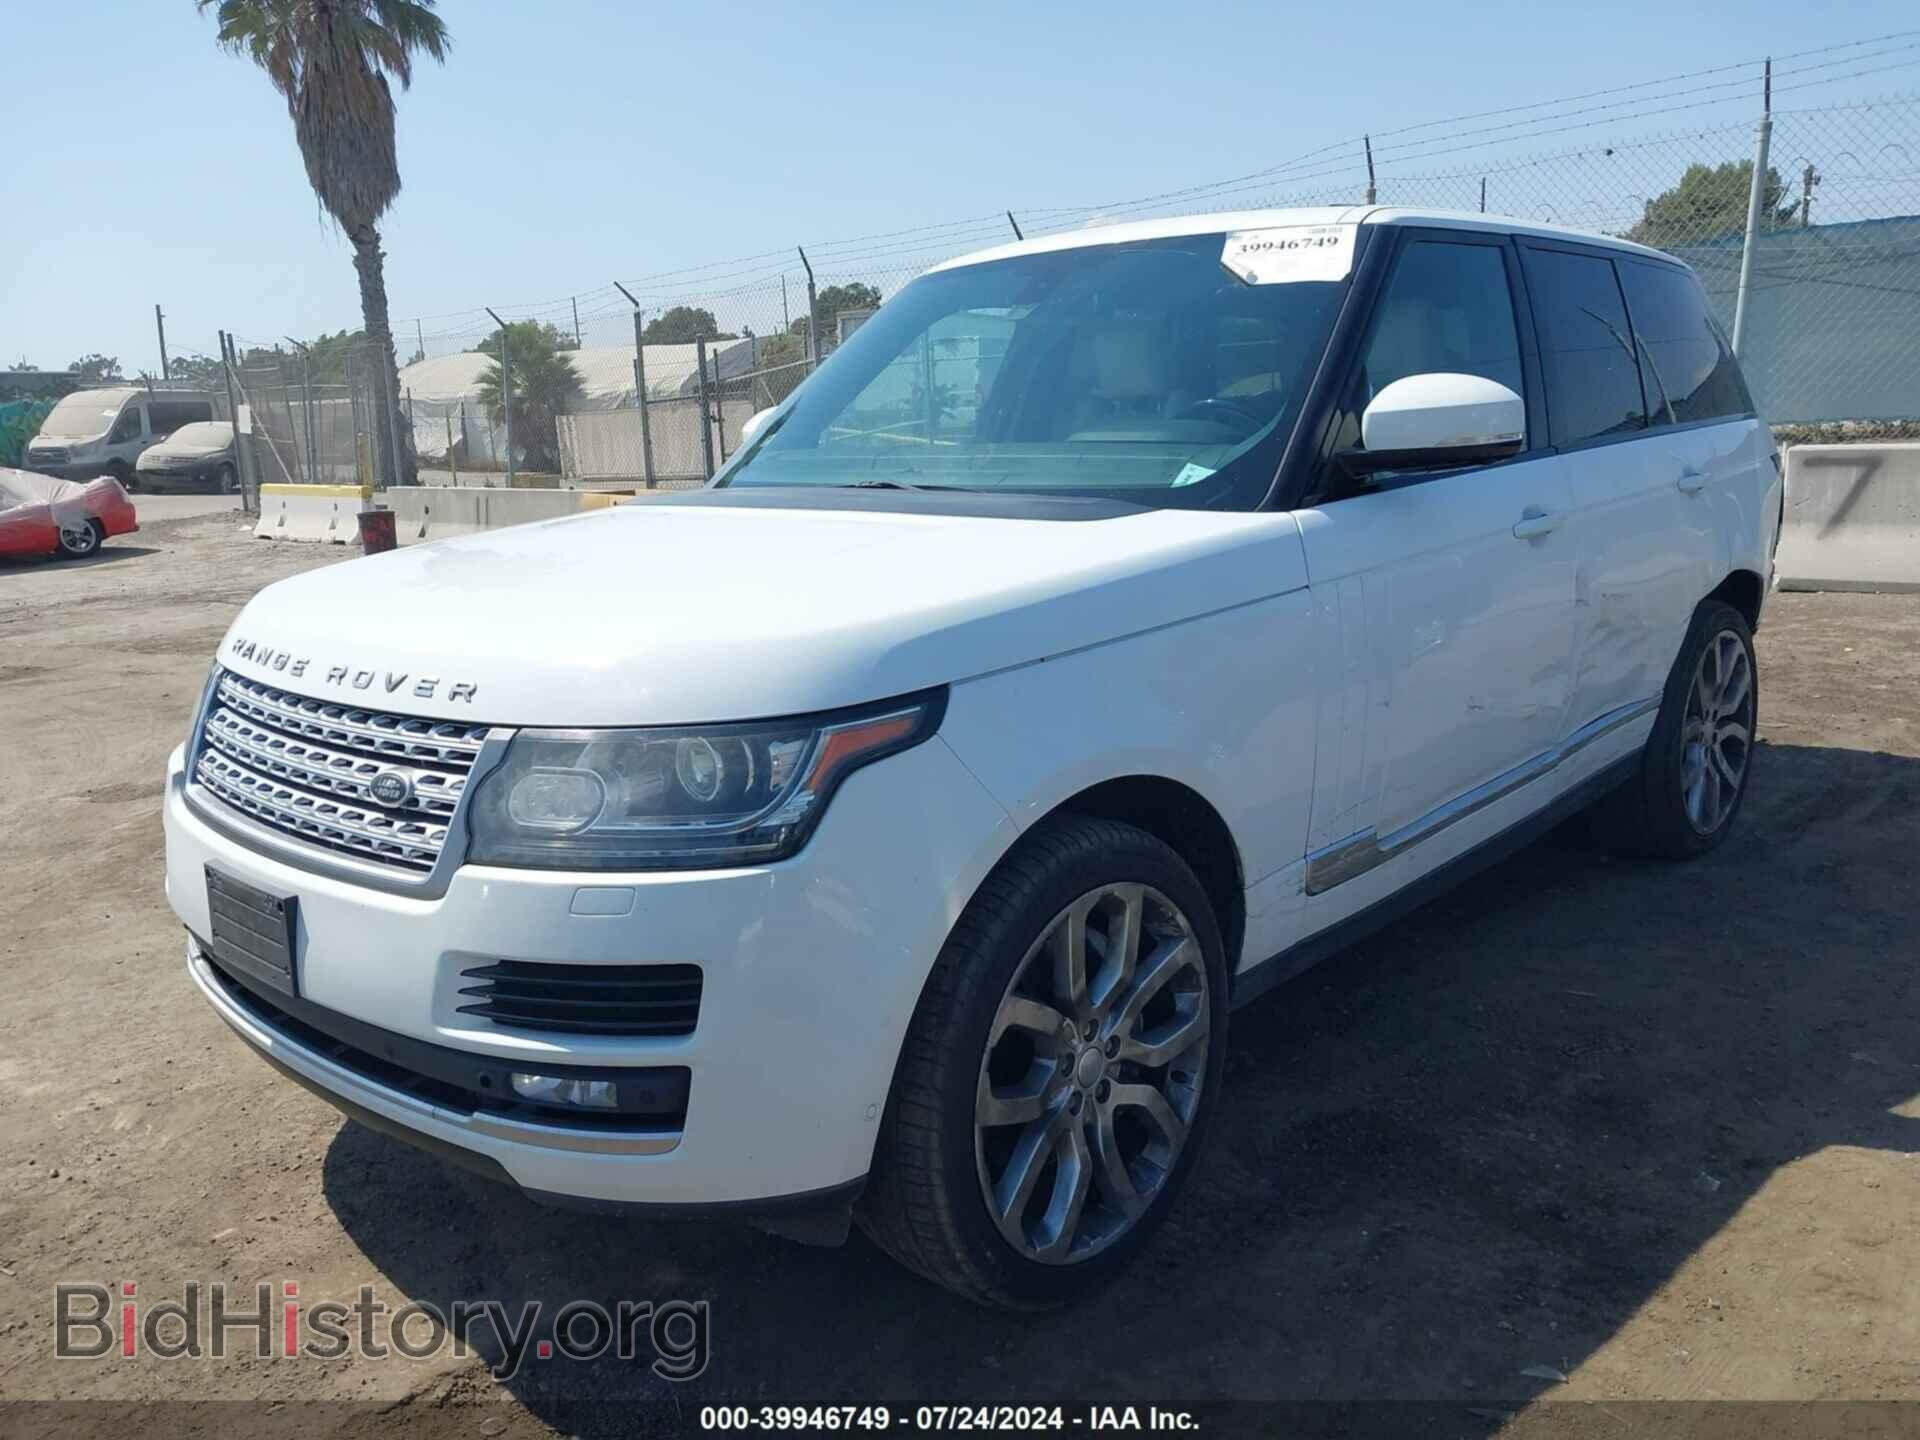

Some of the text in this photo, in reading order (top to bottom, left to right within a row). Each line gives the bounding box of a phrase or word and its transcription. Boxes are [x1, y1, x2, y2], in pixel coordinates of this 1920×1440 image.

[1241, 237, 1338, 252] 39946749
[1803, 456, 1884, 541] 7
[232, 639, 477, 703] RANGE ROVER
